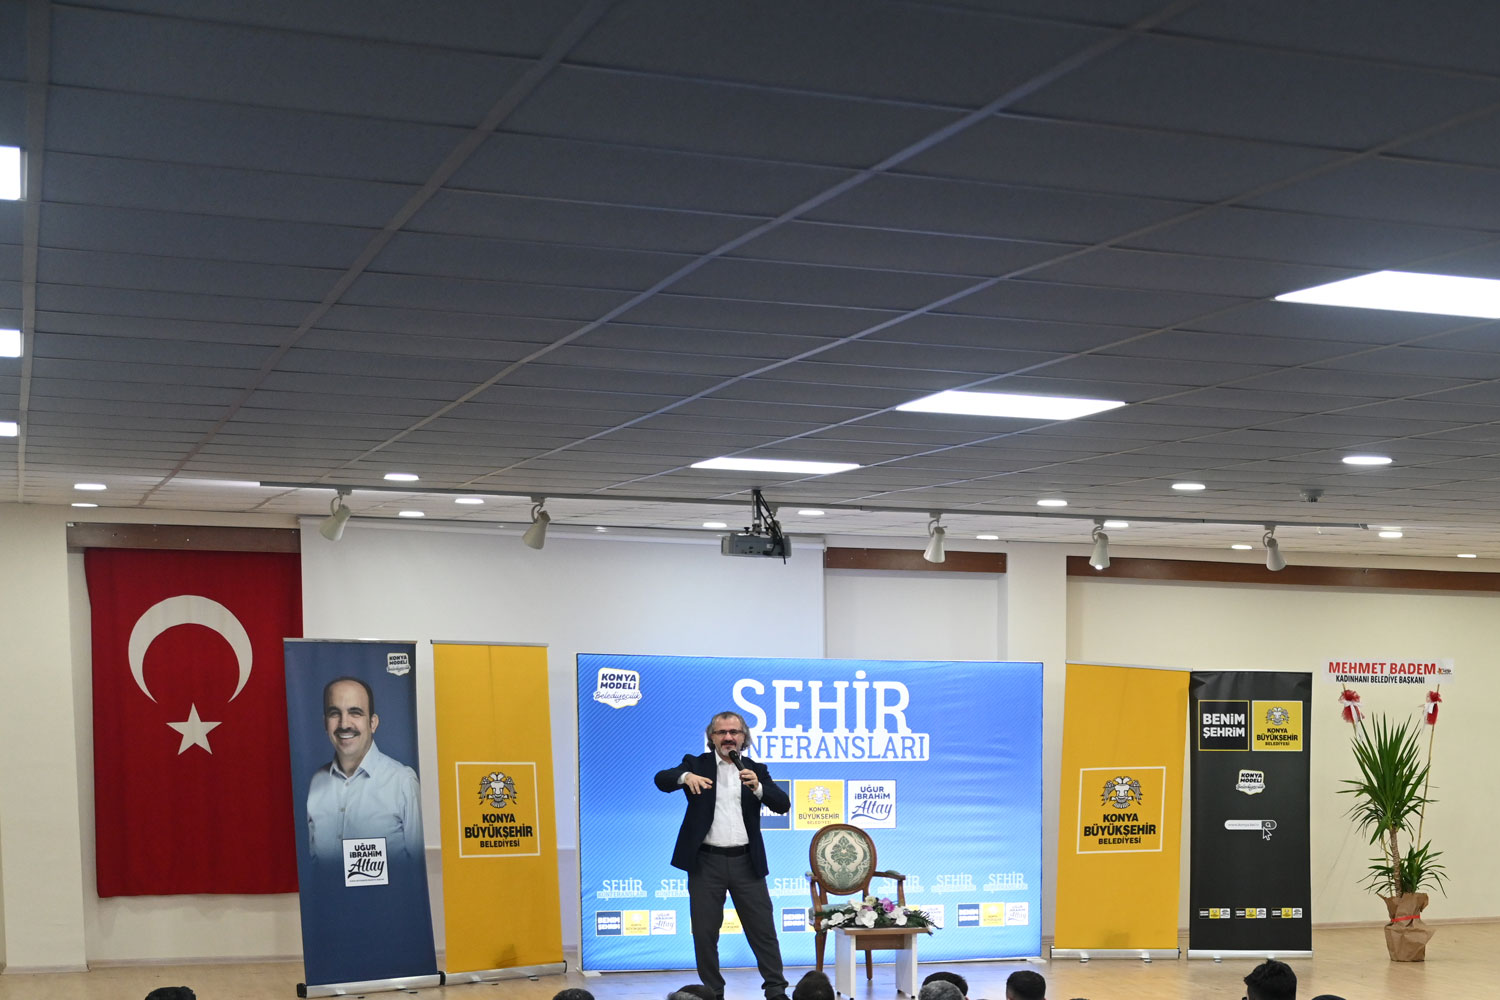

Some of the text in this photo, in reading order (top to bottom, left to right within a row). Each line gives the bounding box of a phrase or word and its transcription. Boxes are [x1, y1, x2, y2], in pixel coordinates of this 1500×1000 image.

[1328, 661, 1387, 674] MEHMET
[1389, 662, 1436, 675] BADEM
[601, 673, 637, 682] KONYA
[1335, 674, 1425, 684] KADINHANI BELEDİYE BAŞKANI
[600, 682, 637, 690] MODELİ
[1202, 713, 1245, 725] BENİM
[1202, 726, 1245, 739] ŞEHRİM
[1256, 733, 1298, 742] BÜYÜKŞEHİR
[747, 735, 926, 760] NFERANSLARI
[860, 784, 884, 793] UĞUR
[851, 800, 893, 821] Altay
[482, 813, 516, 824] KONYA
[1103, 813, 1139, 823] KONYA
[464, 822, 533, 839] BÜYÜKŞEHİR
[1083, 822, 1157, 837] BÜYÜKŞEHİR
[480, 838, 520, 848] BELEDİYESİ
[1098, 835, 1142, 845] BELEDİYESİ
[354, 842, 377, 851] UĞUR
[348, 857, 385, 879] Altay
